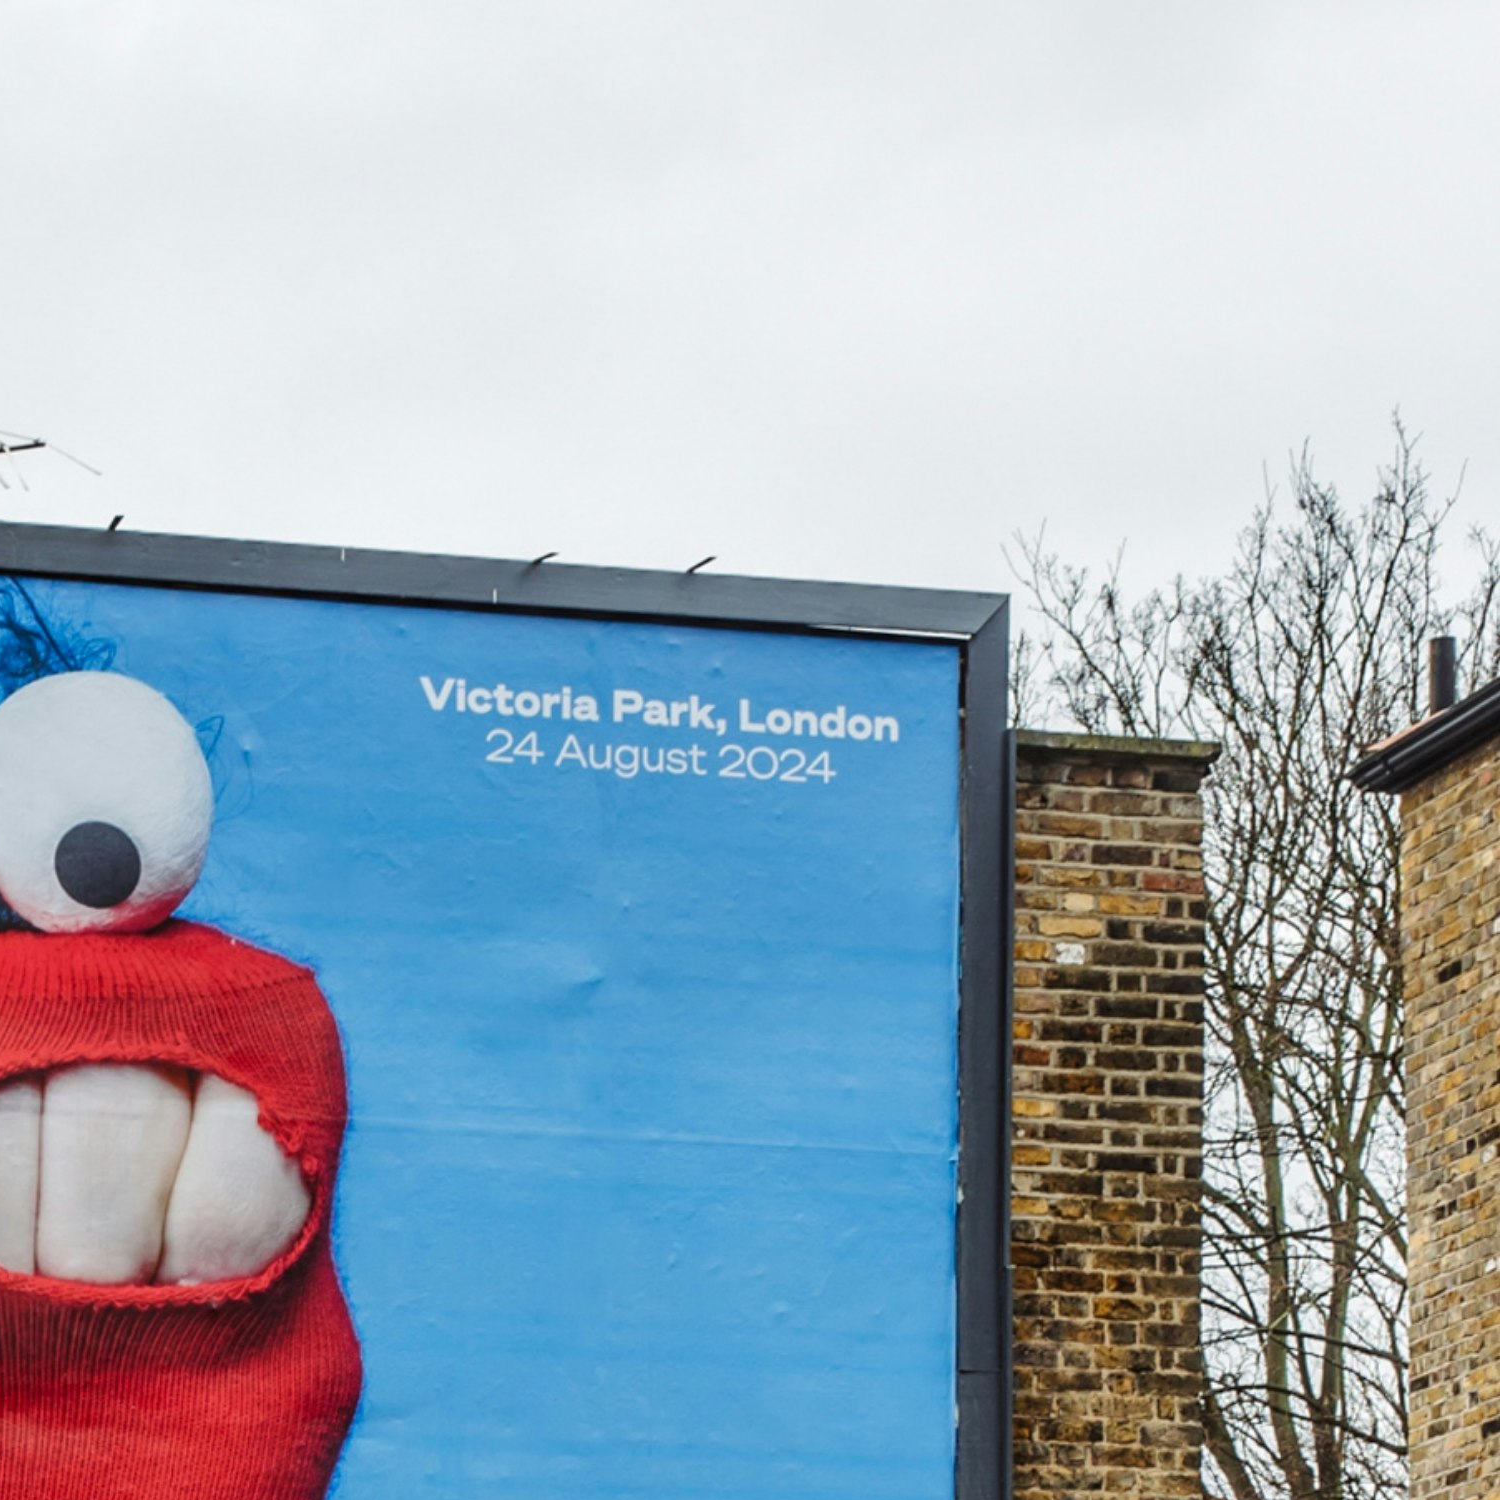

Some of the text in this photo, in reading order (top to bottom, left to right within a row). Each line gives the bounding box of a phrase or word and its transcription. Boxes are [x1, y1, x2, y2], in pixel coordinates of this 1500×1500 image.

[419, 675, 900, 743] Victoria Park, London
[485, 728, 837, 785] 24 August 2024
